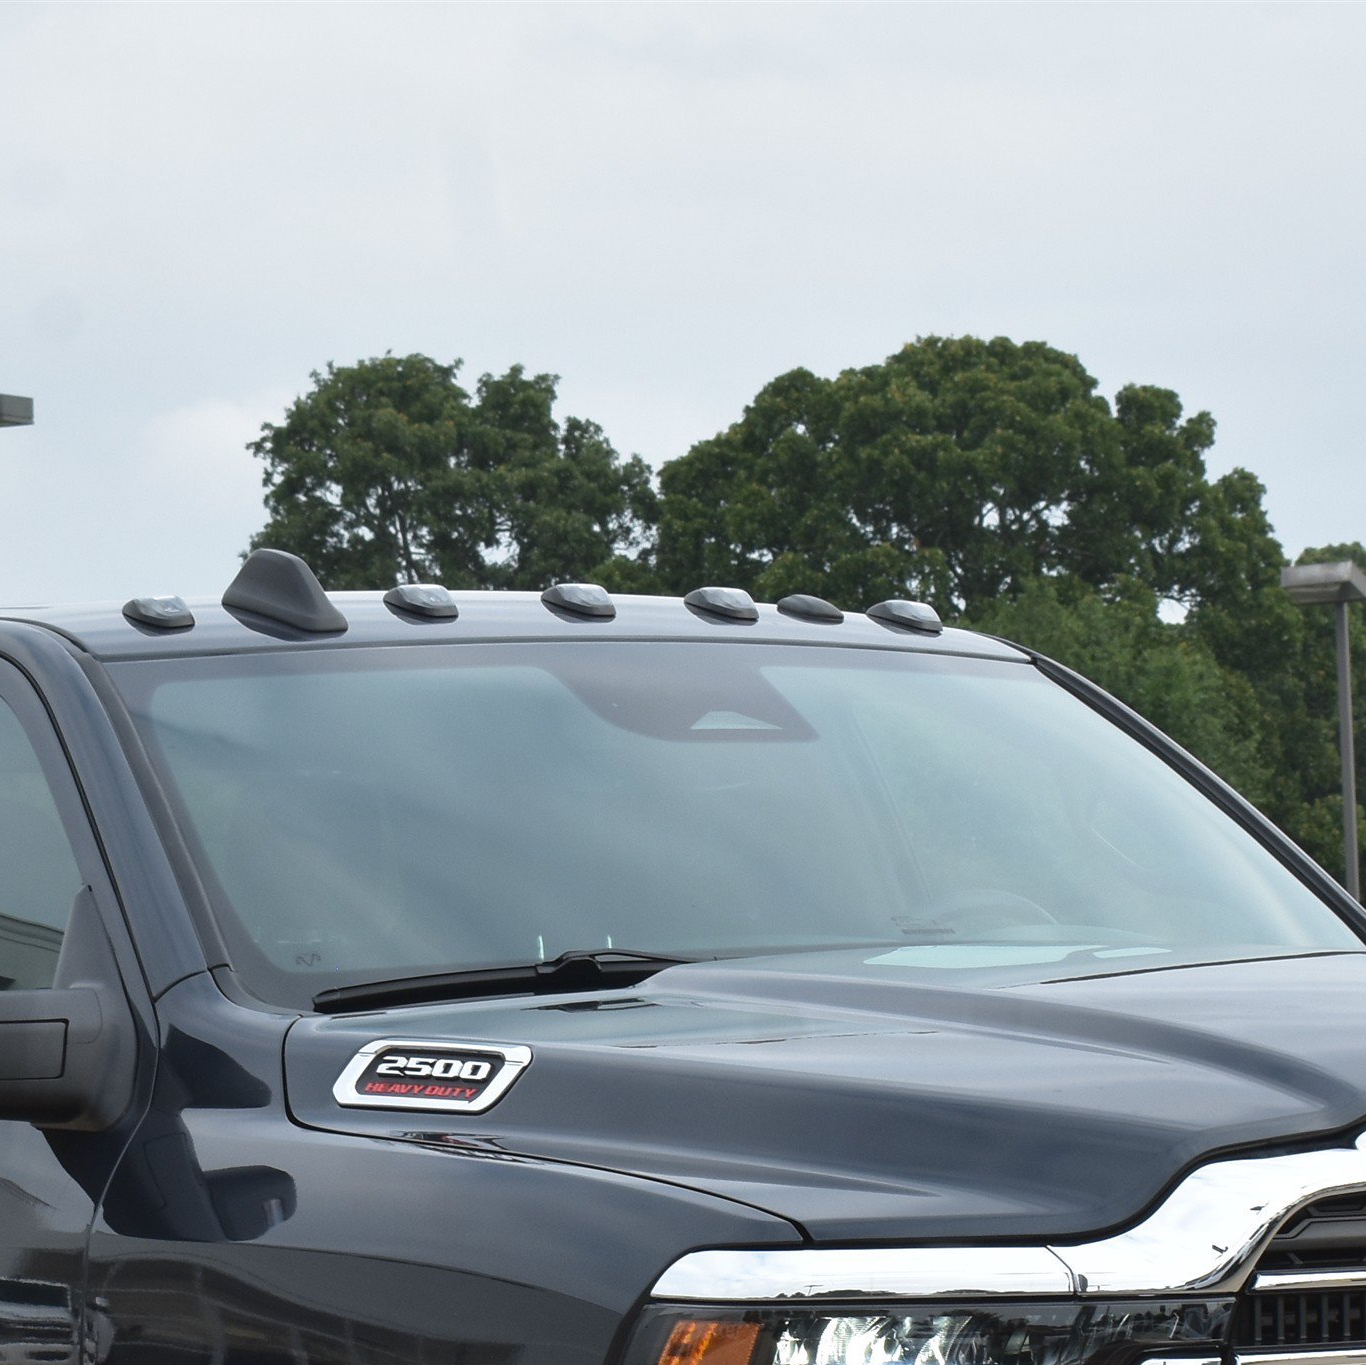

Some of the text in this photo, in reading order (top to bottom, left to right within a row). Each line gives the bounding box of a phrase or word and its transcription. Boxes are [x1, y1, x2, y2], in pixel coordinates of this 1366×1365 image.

[375, 1055, 492, 1081] 2500
[364, 1082, 479, 1099] HEAVY DUTY
